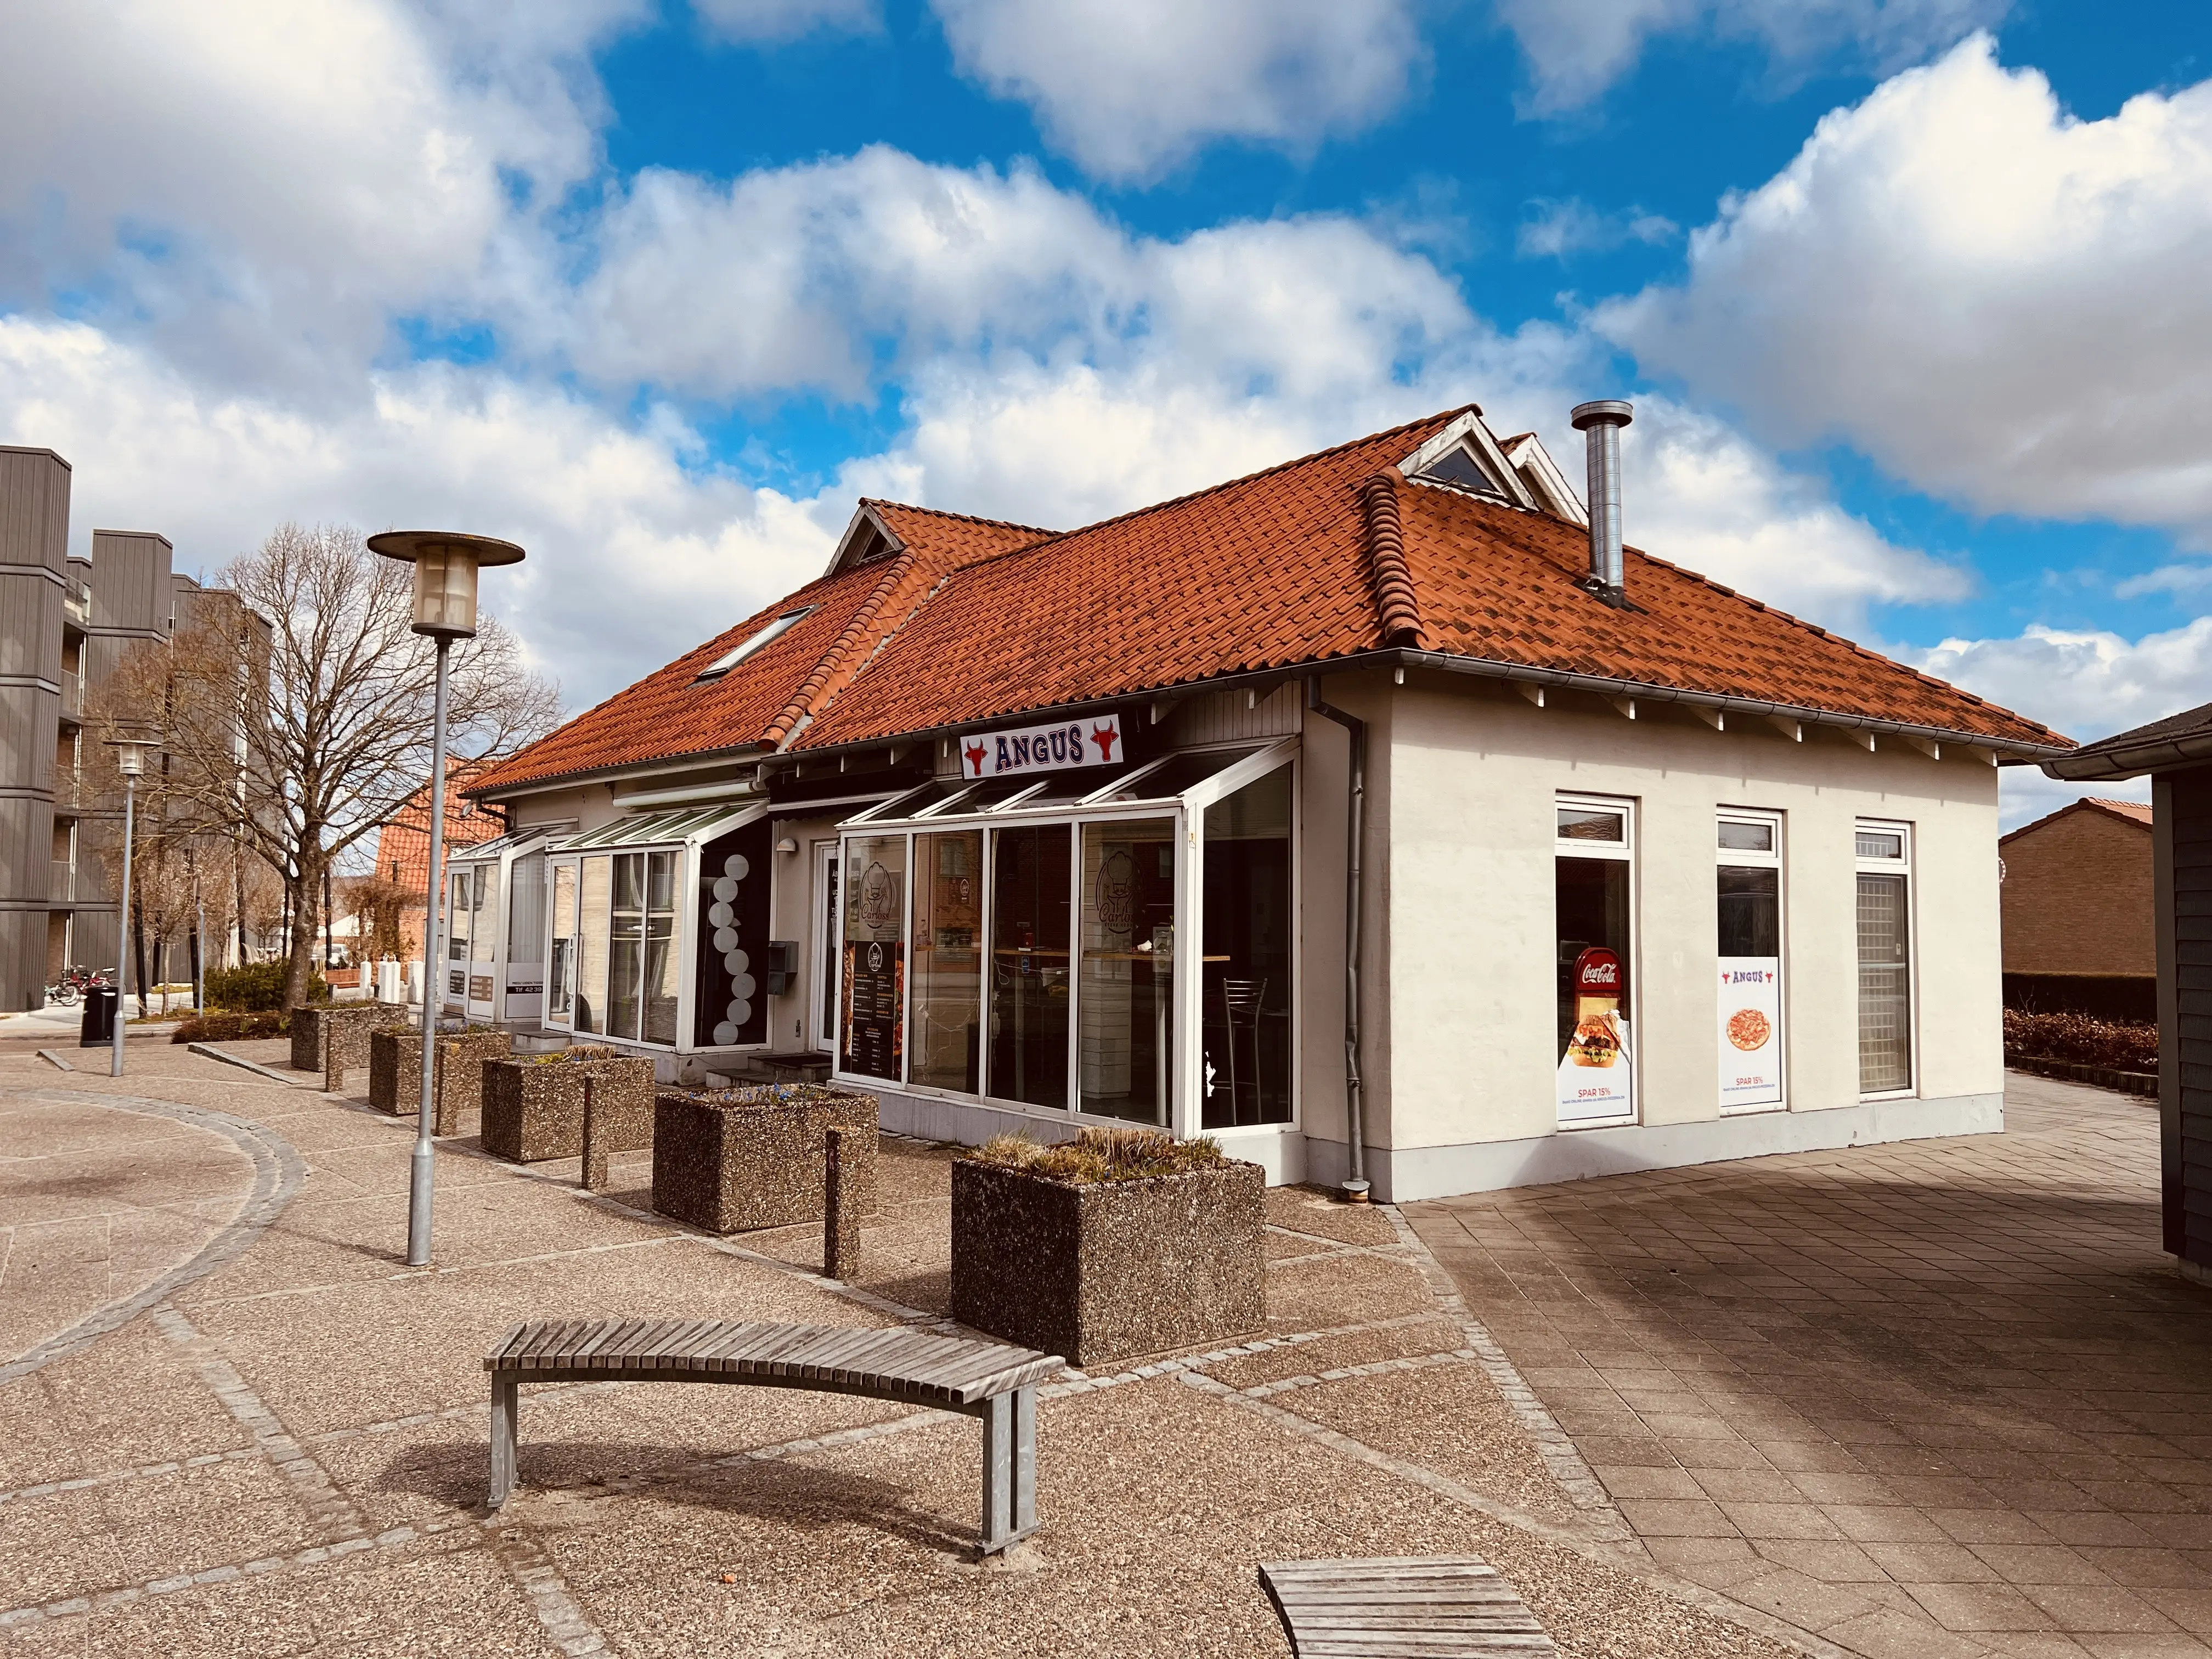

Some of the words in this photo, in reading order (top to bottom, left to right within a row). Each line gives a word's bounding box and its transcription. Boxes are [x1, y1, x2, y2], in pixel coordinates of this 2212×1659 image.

[995, 724, 1085, 774] ANGUS
[1582, 963, 1617, 983] Coca-Cola
[1733, 970, 1763, 984] ANGUS
[1736, 1077, 1752, 1086] SPAR
[1753, 1076, 1763, 1085] 15%
[1578, 1088, 1597, 1098] SPAR
[1598, 1087, 1611, 1096] 15%
